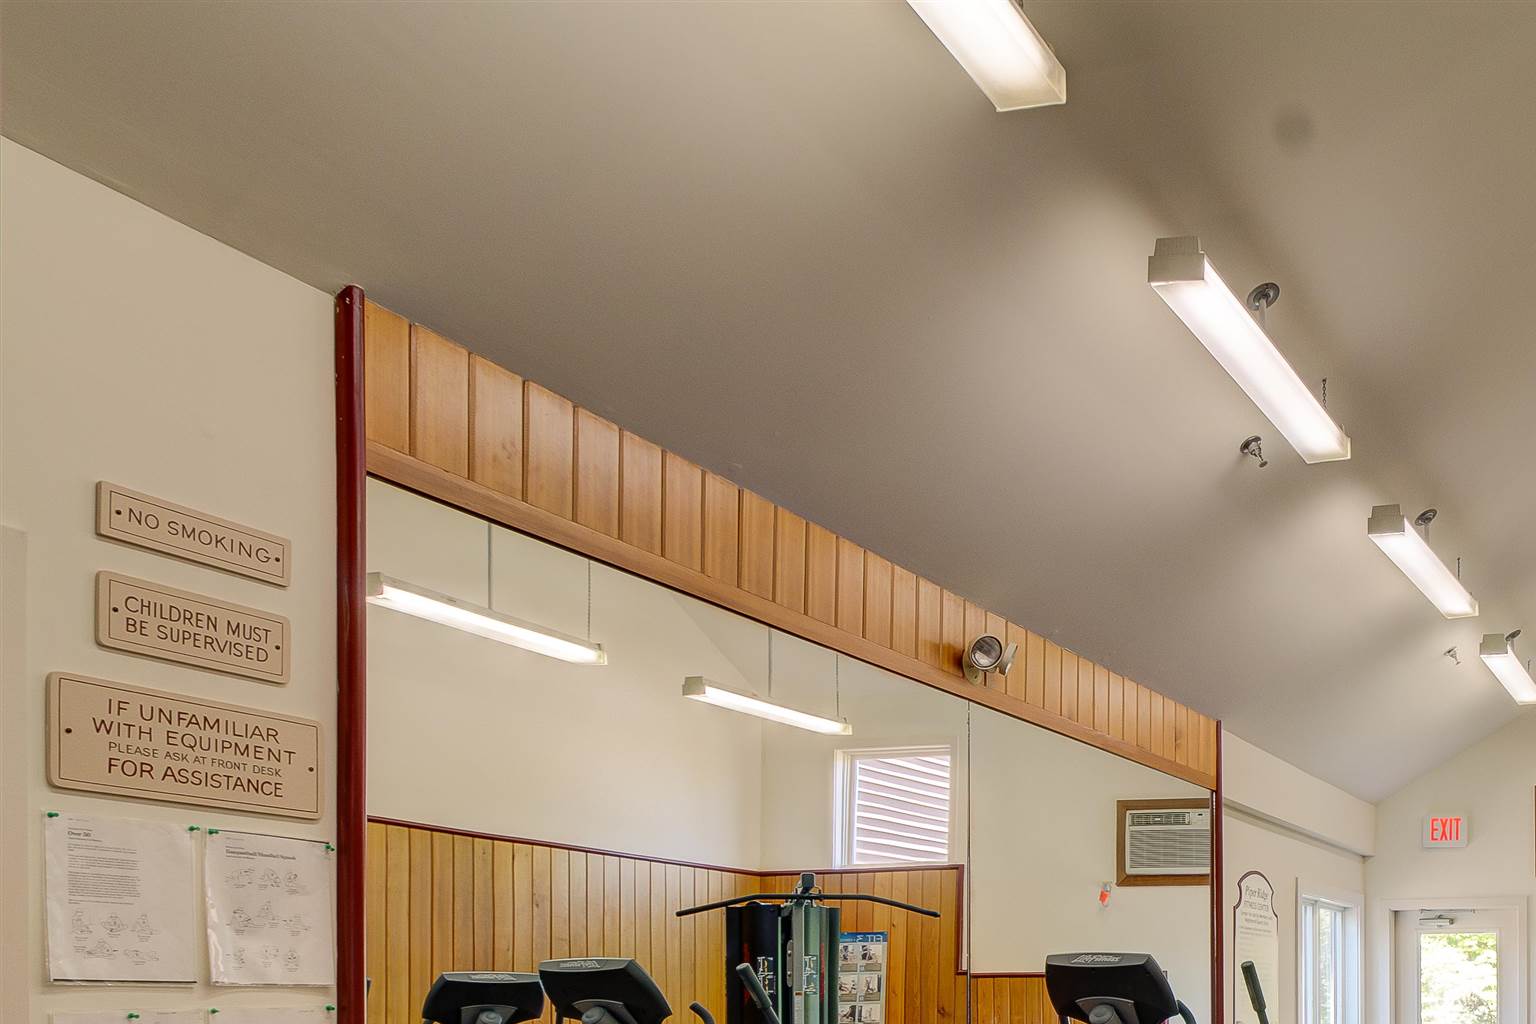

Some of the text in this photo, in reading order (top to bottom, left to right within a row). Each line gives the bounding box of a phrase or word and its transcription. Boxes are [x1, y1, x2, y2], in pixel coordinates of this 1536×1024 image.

[128, 507, 272, 564] NO SMOKING
[124, 596, 272, 645] CHILDREN MUST
[125, 616, 269, 663] BE SUPERVISED
[92, 717, 297, 766] WITH EQUIPMENT
[107, 698, 280, 744] IF UNFAMILIAR
[107, 757, 284, 798] FOR ASSISTANCE
[108, 741, 283, 778] PLEASE ASK AT FRONT DESK
[1430, 818, 1462, 841] EXIT
